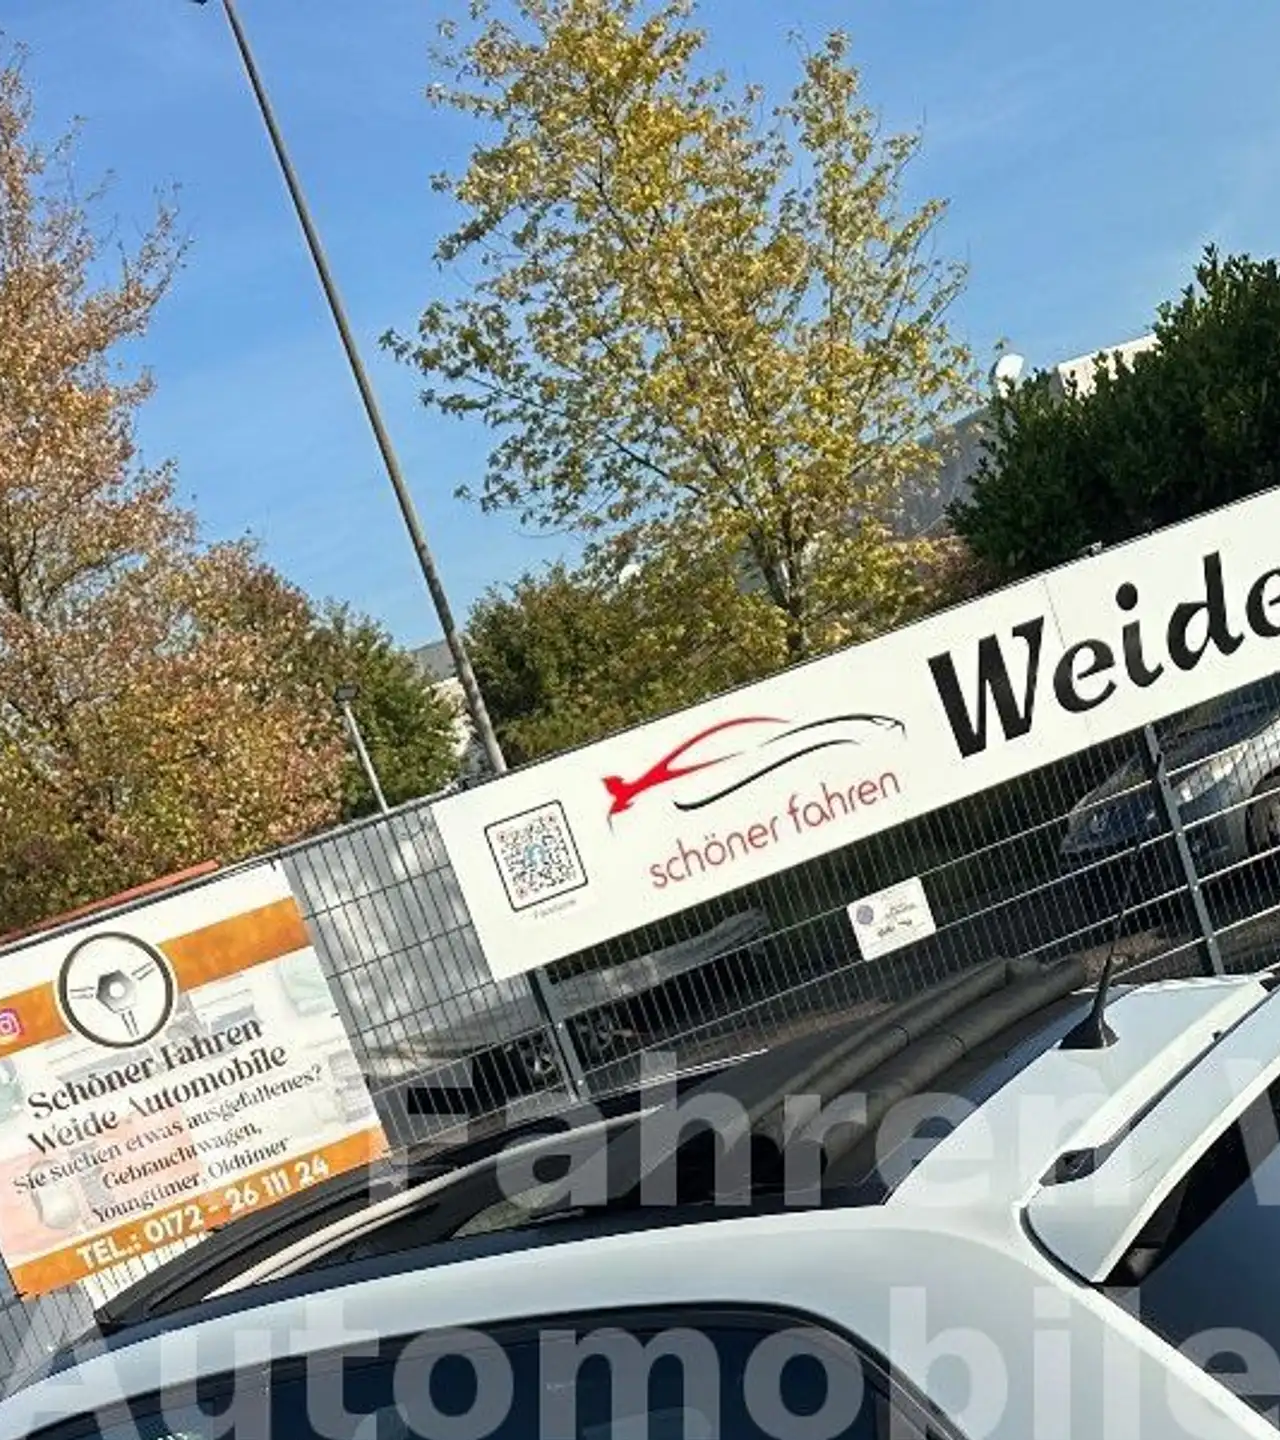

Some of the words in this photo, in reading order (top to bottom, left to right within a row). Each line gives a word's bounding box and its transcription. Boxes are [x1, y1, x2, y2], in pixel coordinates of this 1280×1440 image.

[649, 814, 781, 890] schöner
[786, 768, 902, 834] fahren
[26, 1108, 119, 1156] Weide
[125, 1044, 289, 1125] Automobile
[27, 1057, 155, 1120] Schöner
[161, 1018, 263, 1072] Fahren
[13, 1169, 48, 1196] Sie
[49, 1144, 122, 1184] suchen
[125, 1121, 184, 1154] etwas
[207, 1136, 291, 1180] Oldtimer
[75, 1233, 144, 1270] TEL.:
[143, 1205, 205, 1242] 0172
[224, 1183, 260, 1213] 26
[261, 1169, 291, 1198] 111
[293, 1154, 331, 1188] 24
